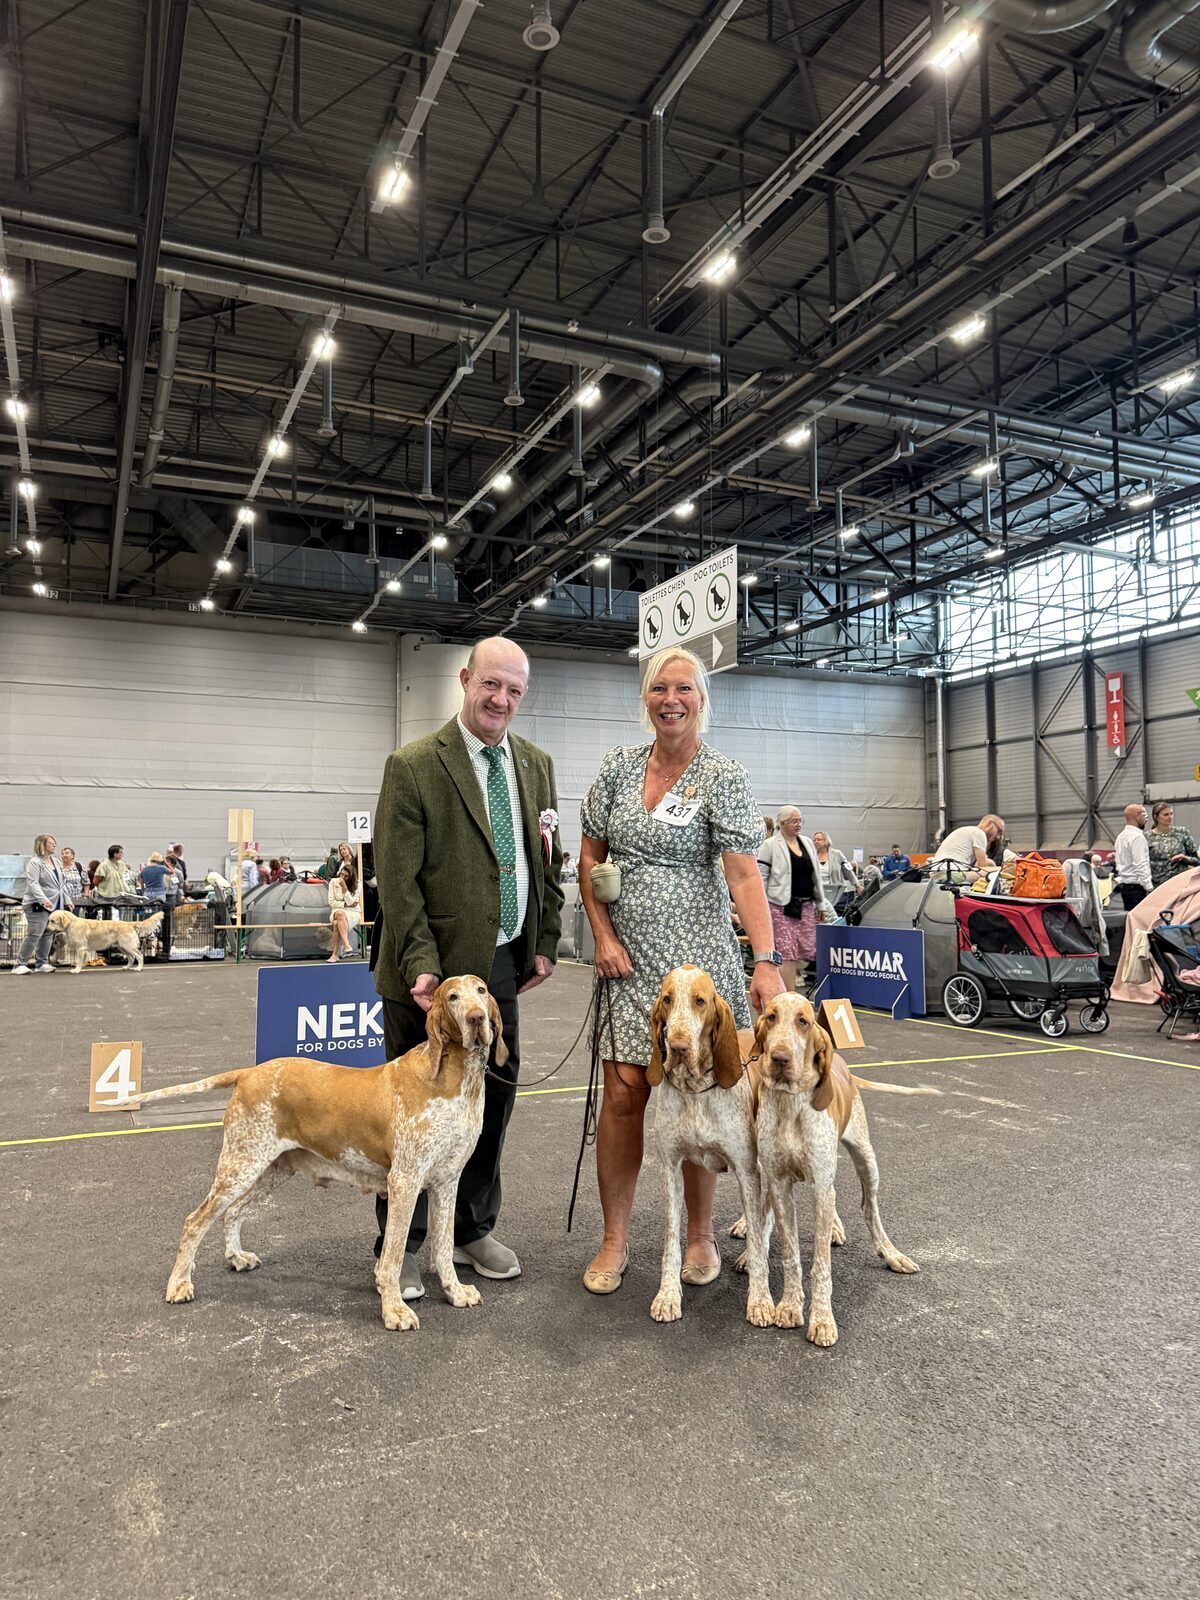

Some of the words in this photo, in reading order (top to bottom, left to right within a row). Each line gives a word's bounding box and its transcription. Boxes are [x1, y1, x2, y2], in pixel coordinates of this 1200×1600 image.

[693, 569, 708, 582] DOG
[708, 554, 734, 574] TOILETS
[641, 587, 667, 607] TOILETTES
[668, 578, 686, 593] CHIEN
[350, 816, 368, 829] 12
[665, 804, 692, 819] 437
[829, 946, 908, 981] NEKMAR
[841, 968, 857, 976] DOGS
[857, 969, 864, 977] BY
[879, 972, 901, 980] PEOPLE
[833, 1004, 857, 1042] 1
[296, 1043, 323, 1053] FOR
[328, 1039, 364, 1051] DOGS
[368, 1037, 384, 1048] BY
[95, 1048, 136, 1100] 4
